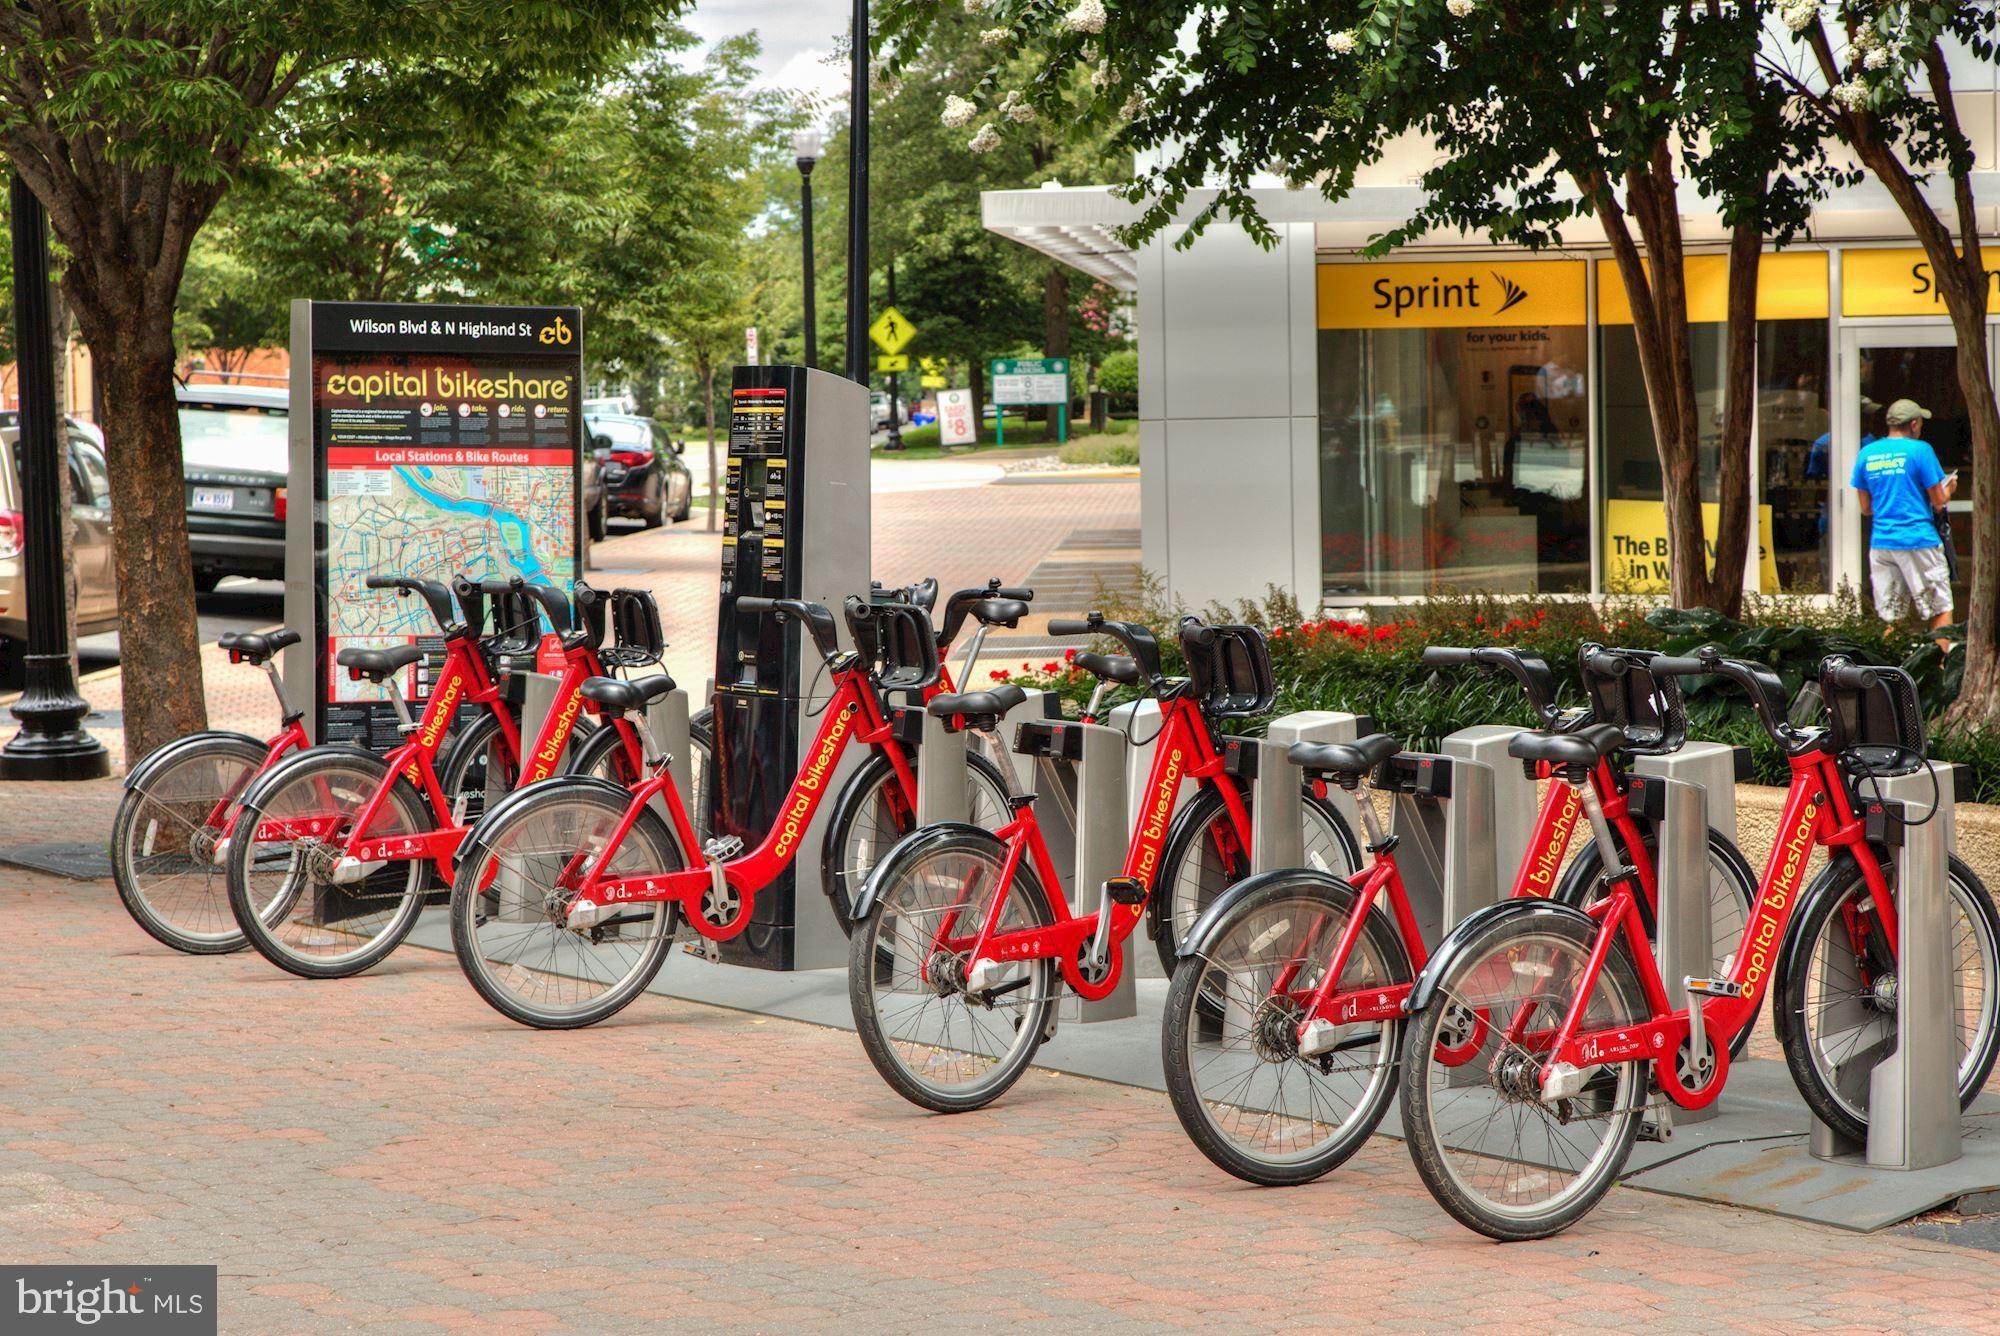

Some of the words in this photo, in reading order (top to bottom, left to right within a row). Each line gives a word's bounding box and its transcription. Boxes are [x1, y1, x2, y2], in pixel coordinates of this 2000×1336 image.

[1373, 277, 1480, 317] Sprint
[350, 319, 396, 334] Wilson
[400, 320, 427, 335] Blvd
[431, 321, 441, 335] &
[446, 322, 455, 335] N
[459, 322, 516, 338] Highland
[519, 323, 532, 337] St
[1467, 331, 1485, 343] for
[1488, 333, 1516, 345] your
[1519, 330, 1550, 342] kids.
[327, 368, 427, 403] capital
[434, 366, 568, 400] bikeshare
[376, 450, 405, 462] Local
[408, 450, 453, 463] Stations
[456, 451, 464, 462] &
[466, 450, 489, 463] Bike
[492, 451, 529, 463] Routes
[218, 474, 266, 484] ROVER
[1613, 535, 1650, 556] The
[1629, 559, 1648, 579] in
[421, 675, 462, 747] bikeshare
[538, 687, 582, 762] bikeshare
[775, 793, 811, 858] capital
[799, 708, 851, 790] bikeshare
[1143, 748, 1182, 840] bikeshare
[1529, 787, 1580, 884] bikeshare
[1131, 845, 1157, 918] cpital
[1741, 914, 1777, 999] capital
[1763, 803, 1817, 910] bikeshare
